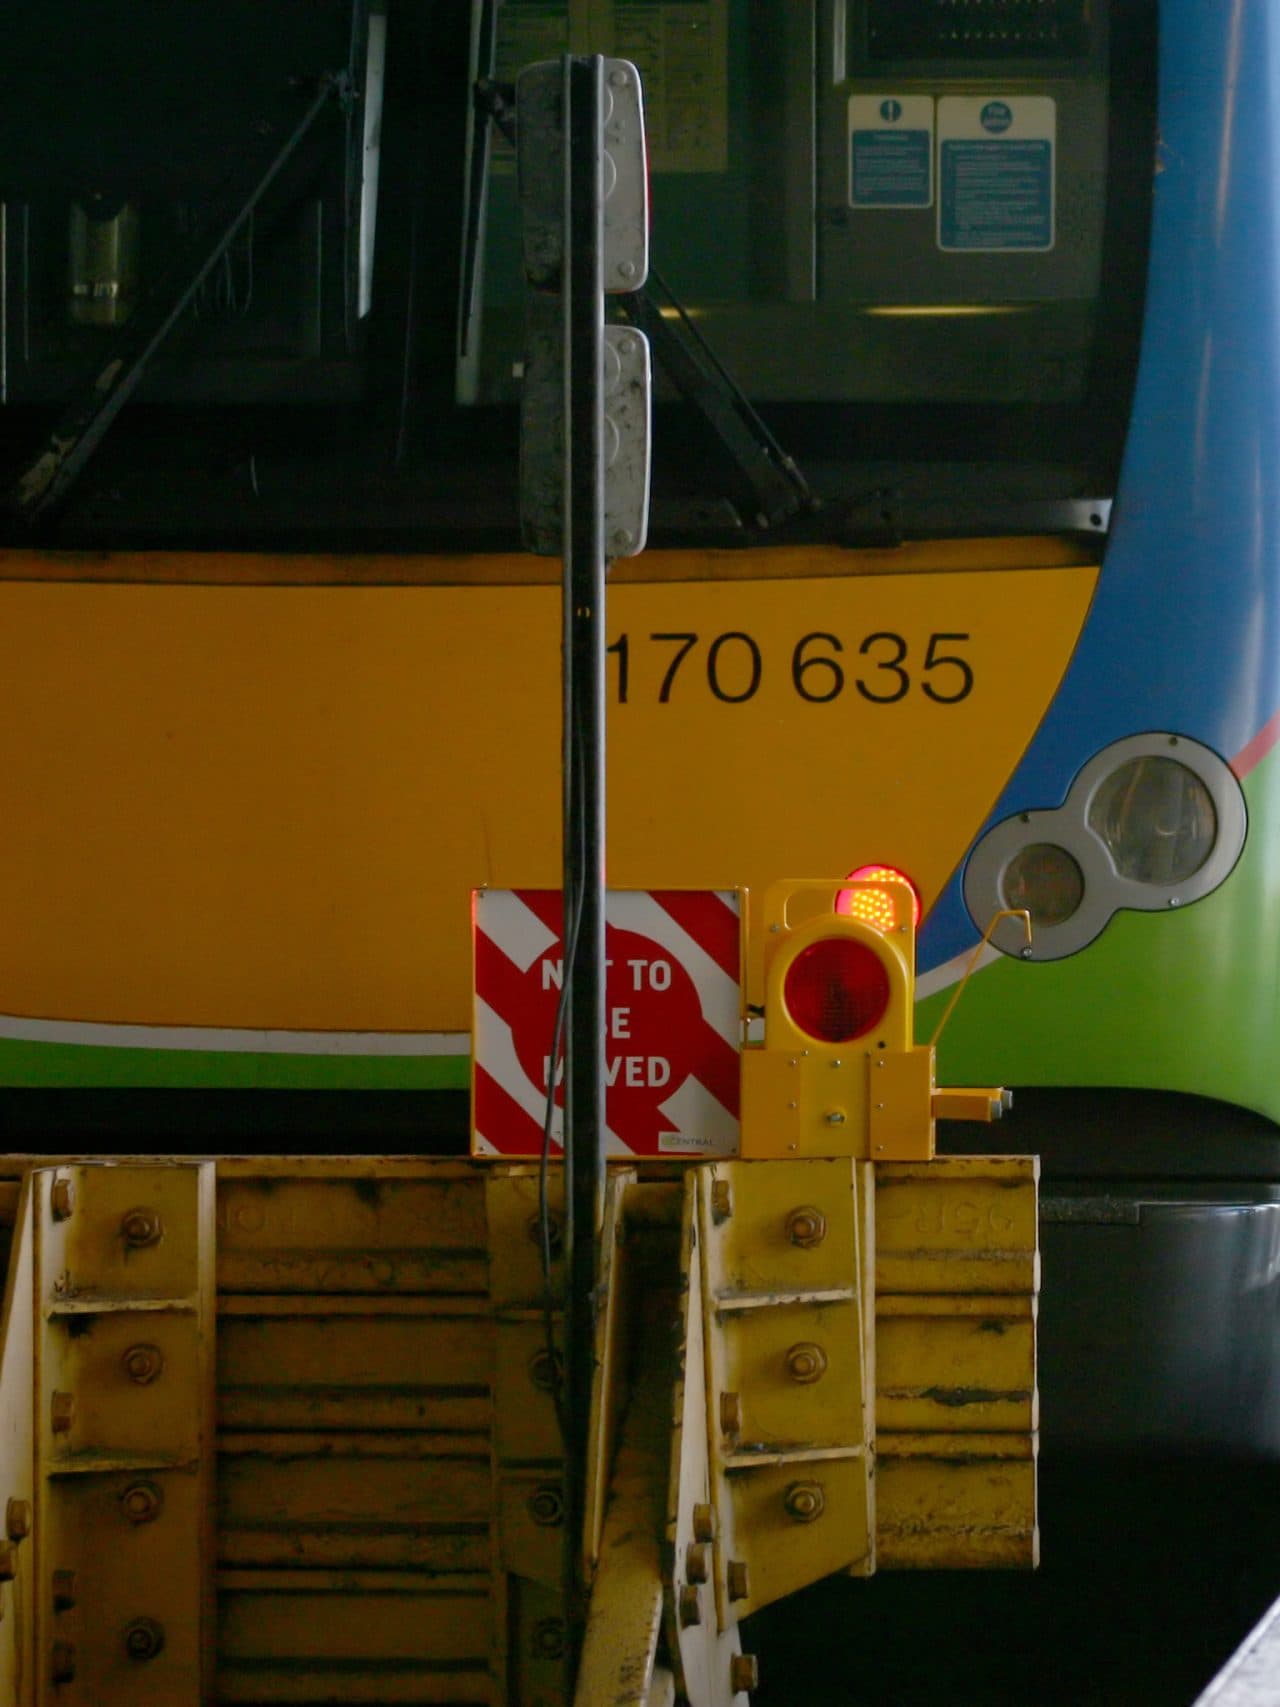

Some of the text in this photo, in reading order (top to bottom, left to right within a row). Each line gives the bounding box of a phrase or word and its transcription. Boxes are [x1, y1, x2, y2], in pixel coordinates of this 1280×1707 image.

[605, 632, 974, 703] 170 635
[627, 960, 671, 991] TO
[605, 1007, 631, 1039] E
